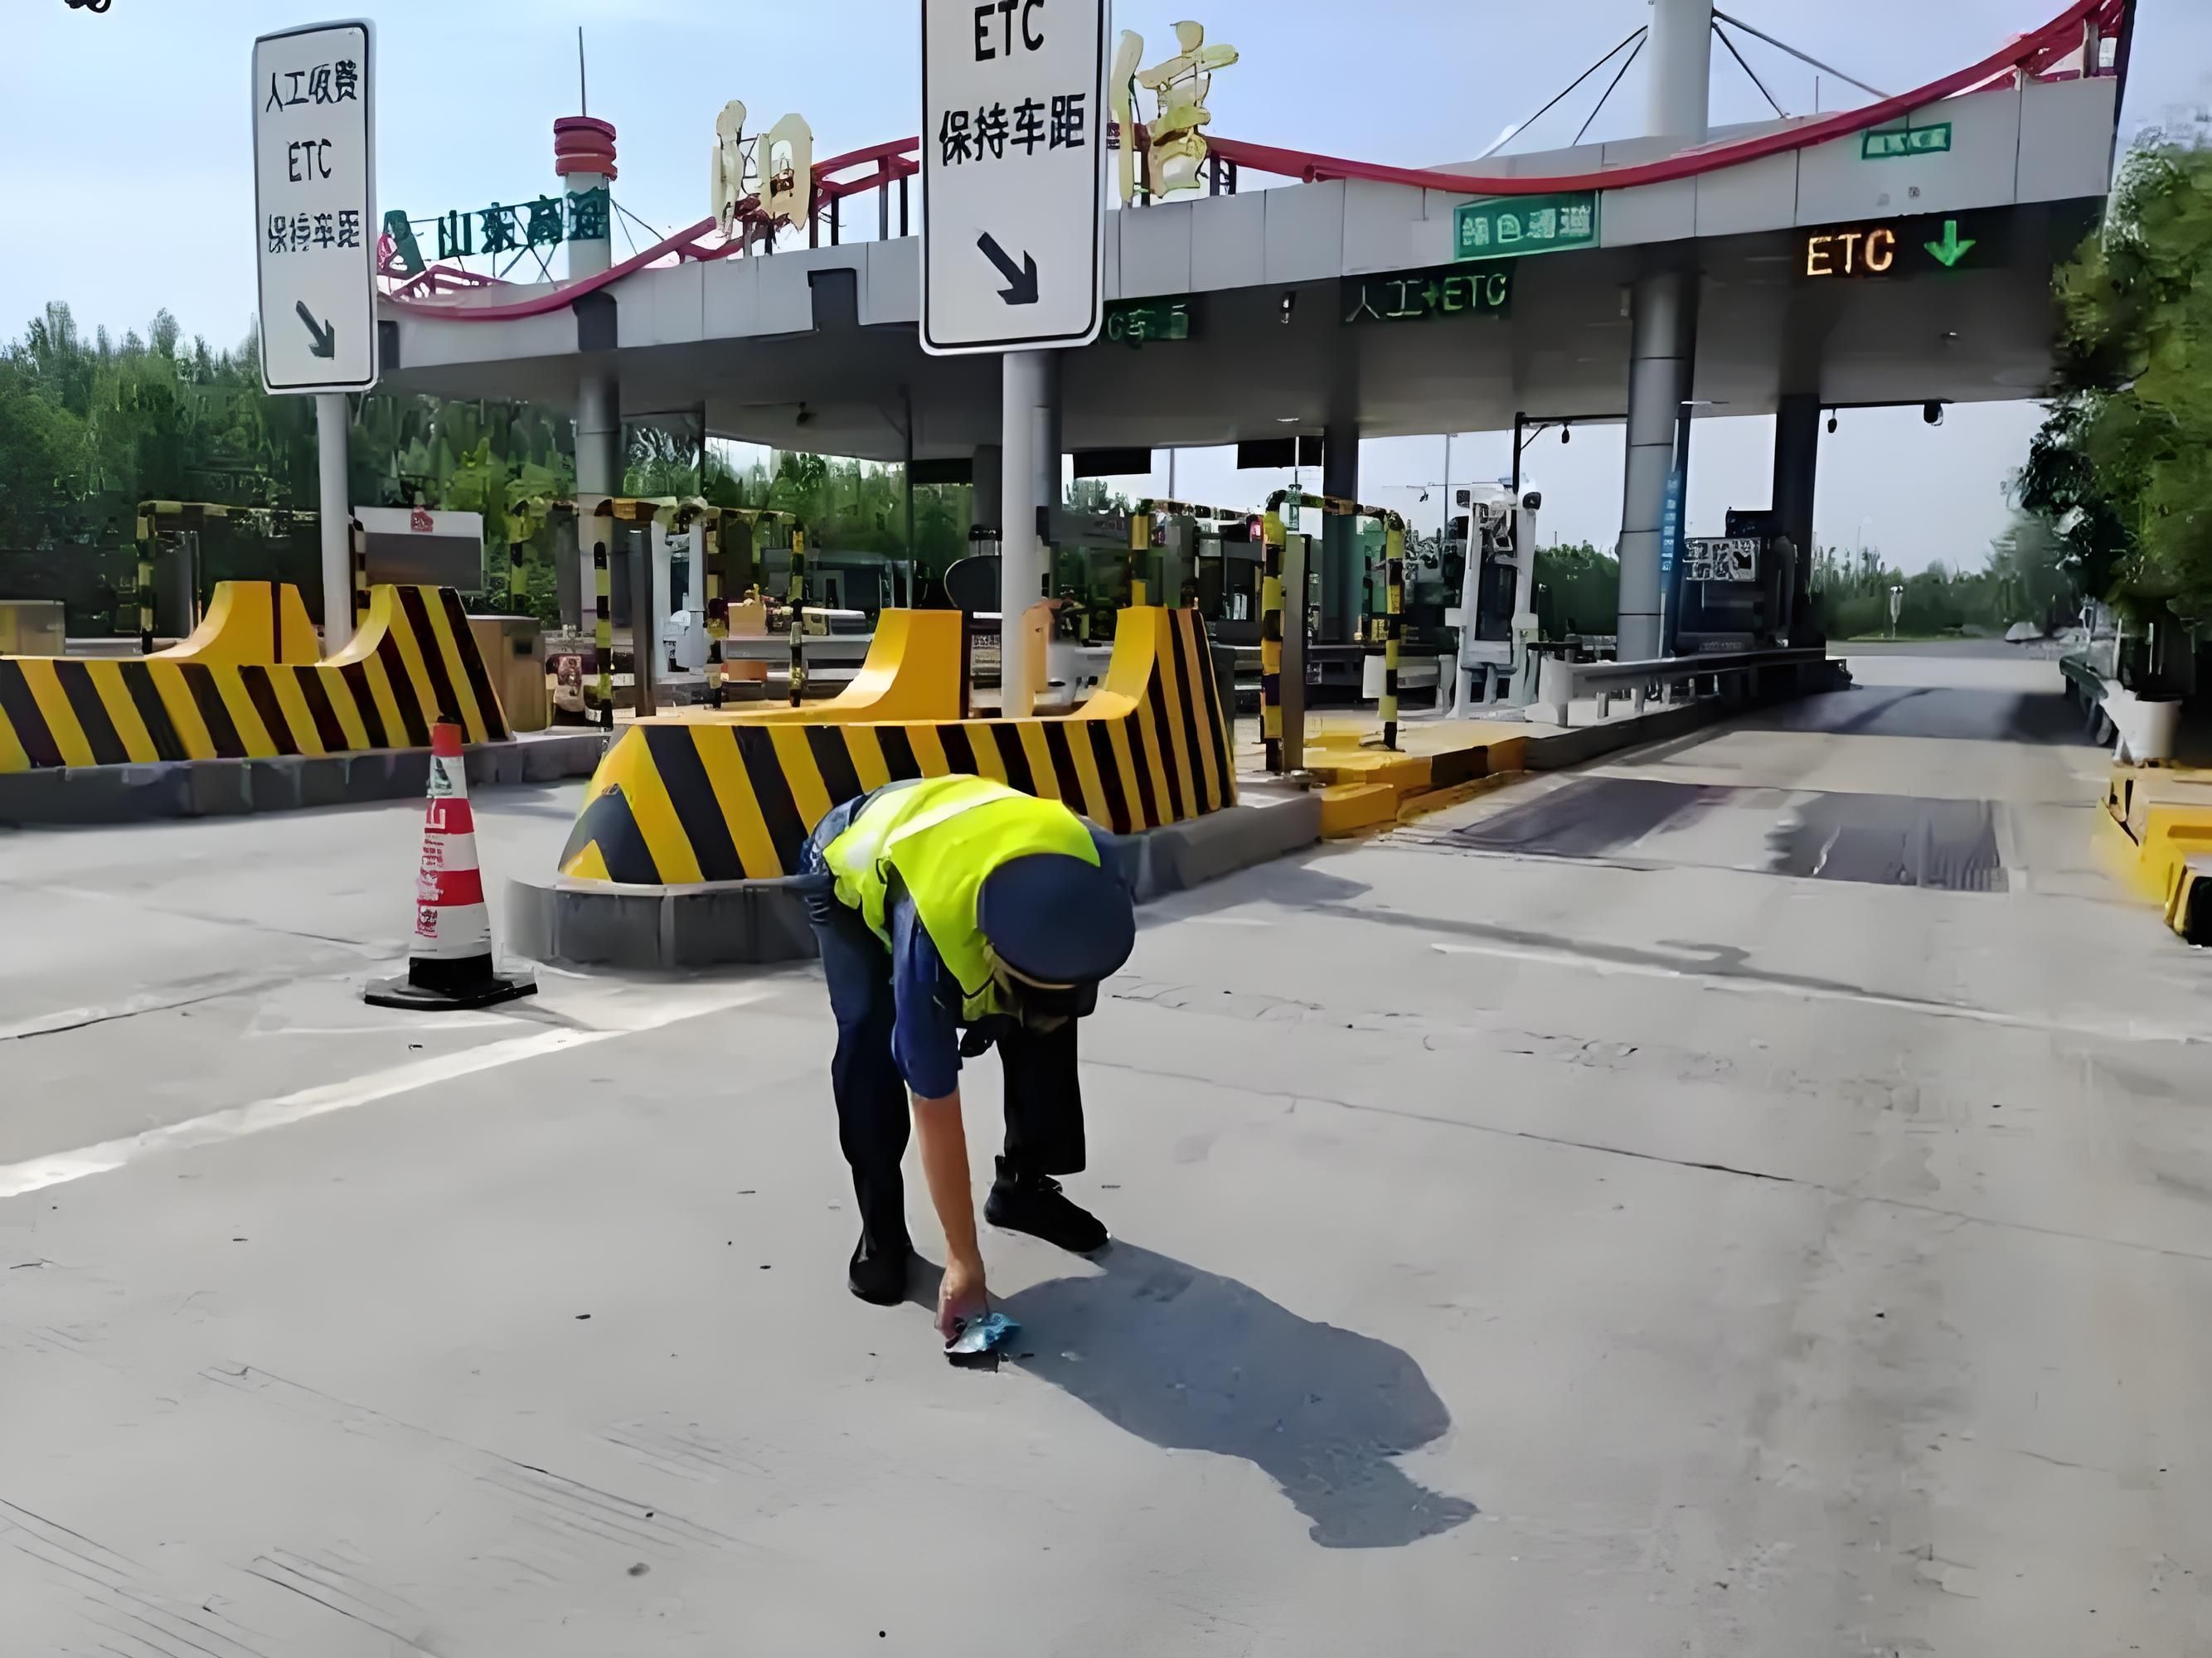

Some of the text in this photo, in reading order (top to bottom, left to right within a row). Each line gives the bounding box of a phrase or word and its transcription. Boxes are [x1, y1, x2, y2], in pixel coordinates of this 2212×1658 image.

[974, 0, 1045, 61] ETC
[939, 93, 1086, 167] 保持车距
[289, 138, 332, 182] ETC
[1807, 229, 1896, 276] ETC
